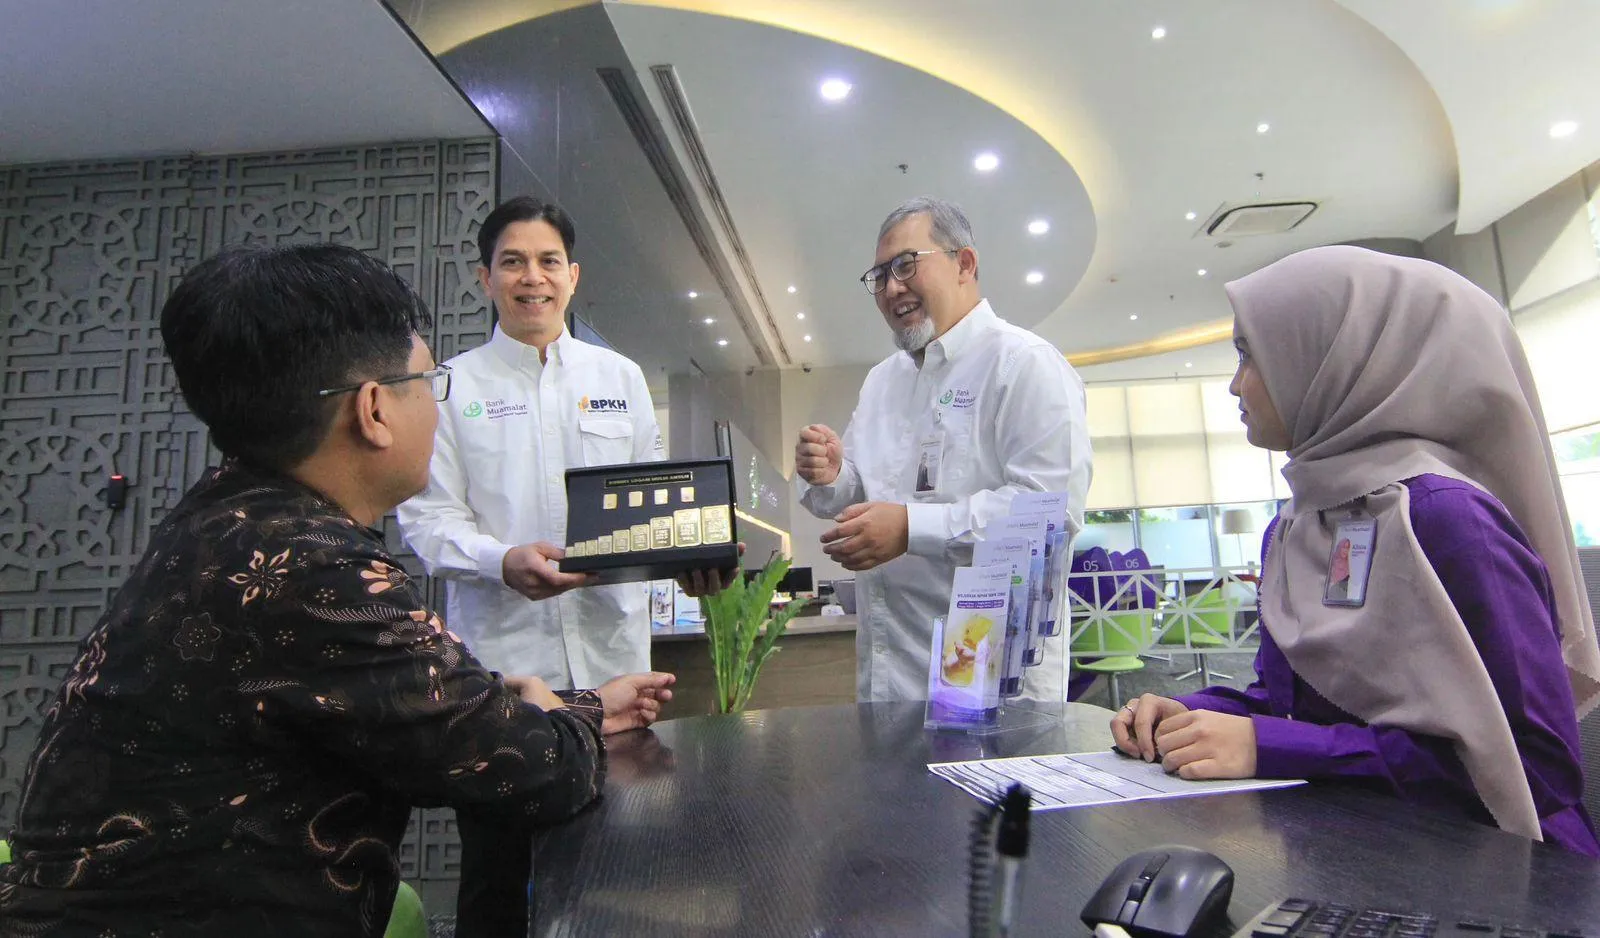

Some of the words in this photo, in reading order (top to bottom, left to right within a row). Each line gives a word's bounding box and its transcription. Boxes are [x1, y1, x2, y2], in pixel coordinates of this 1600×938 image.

[485, 399, 505, 408] Bank
[590, 399, 627, 409] BPKH
[487, 404, 527, 416] Muamalat
[1083, 560, 1099, 571] 05
[1125, 559, 1139, 569] 06
